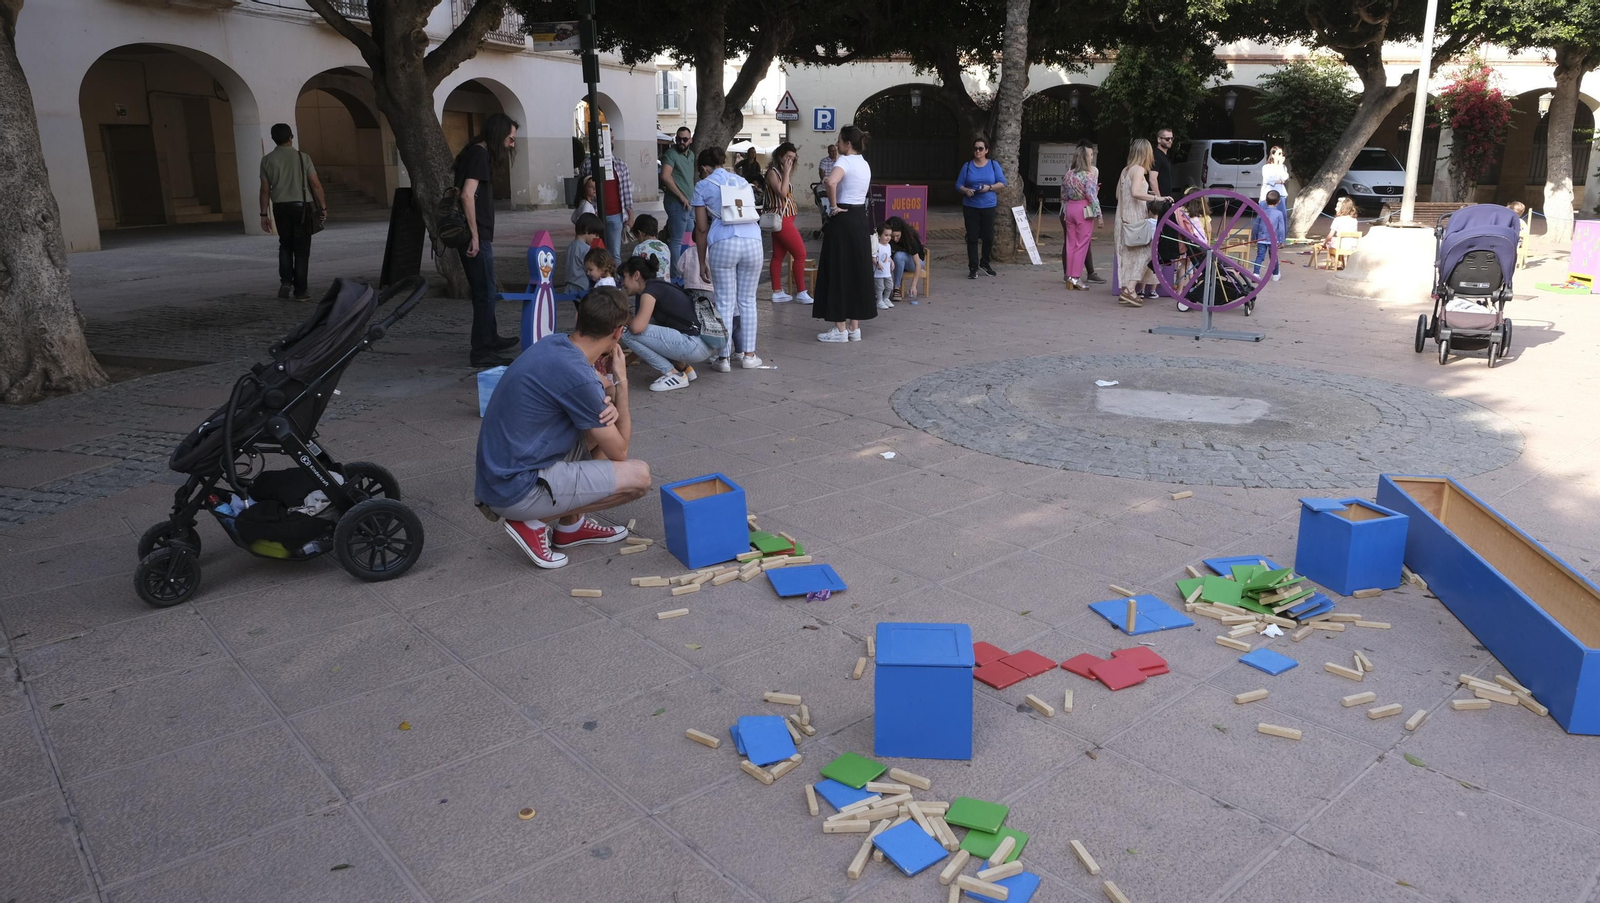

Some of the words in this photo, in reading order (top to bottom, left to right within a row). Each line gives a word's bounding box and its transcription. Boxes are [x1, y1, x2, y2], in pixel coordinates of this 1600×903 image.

[817, 110, 831, 129] P
[891, 197, 922, 210] JUEGOS
[309, 465, 330, 487] Kinderkraft
